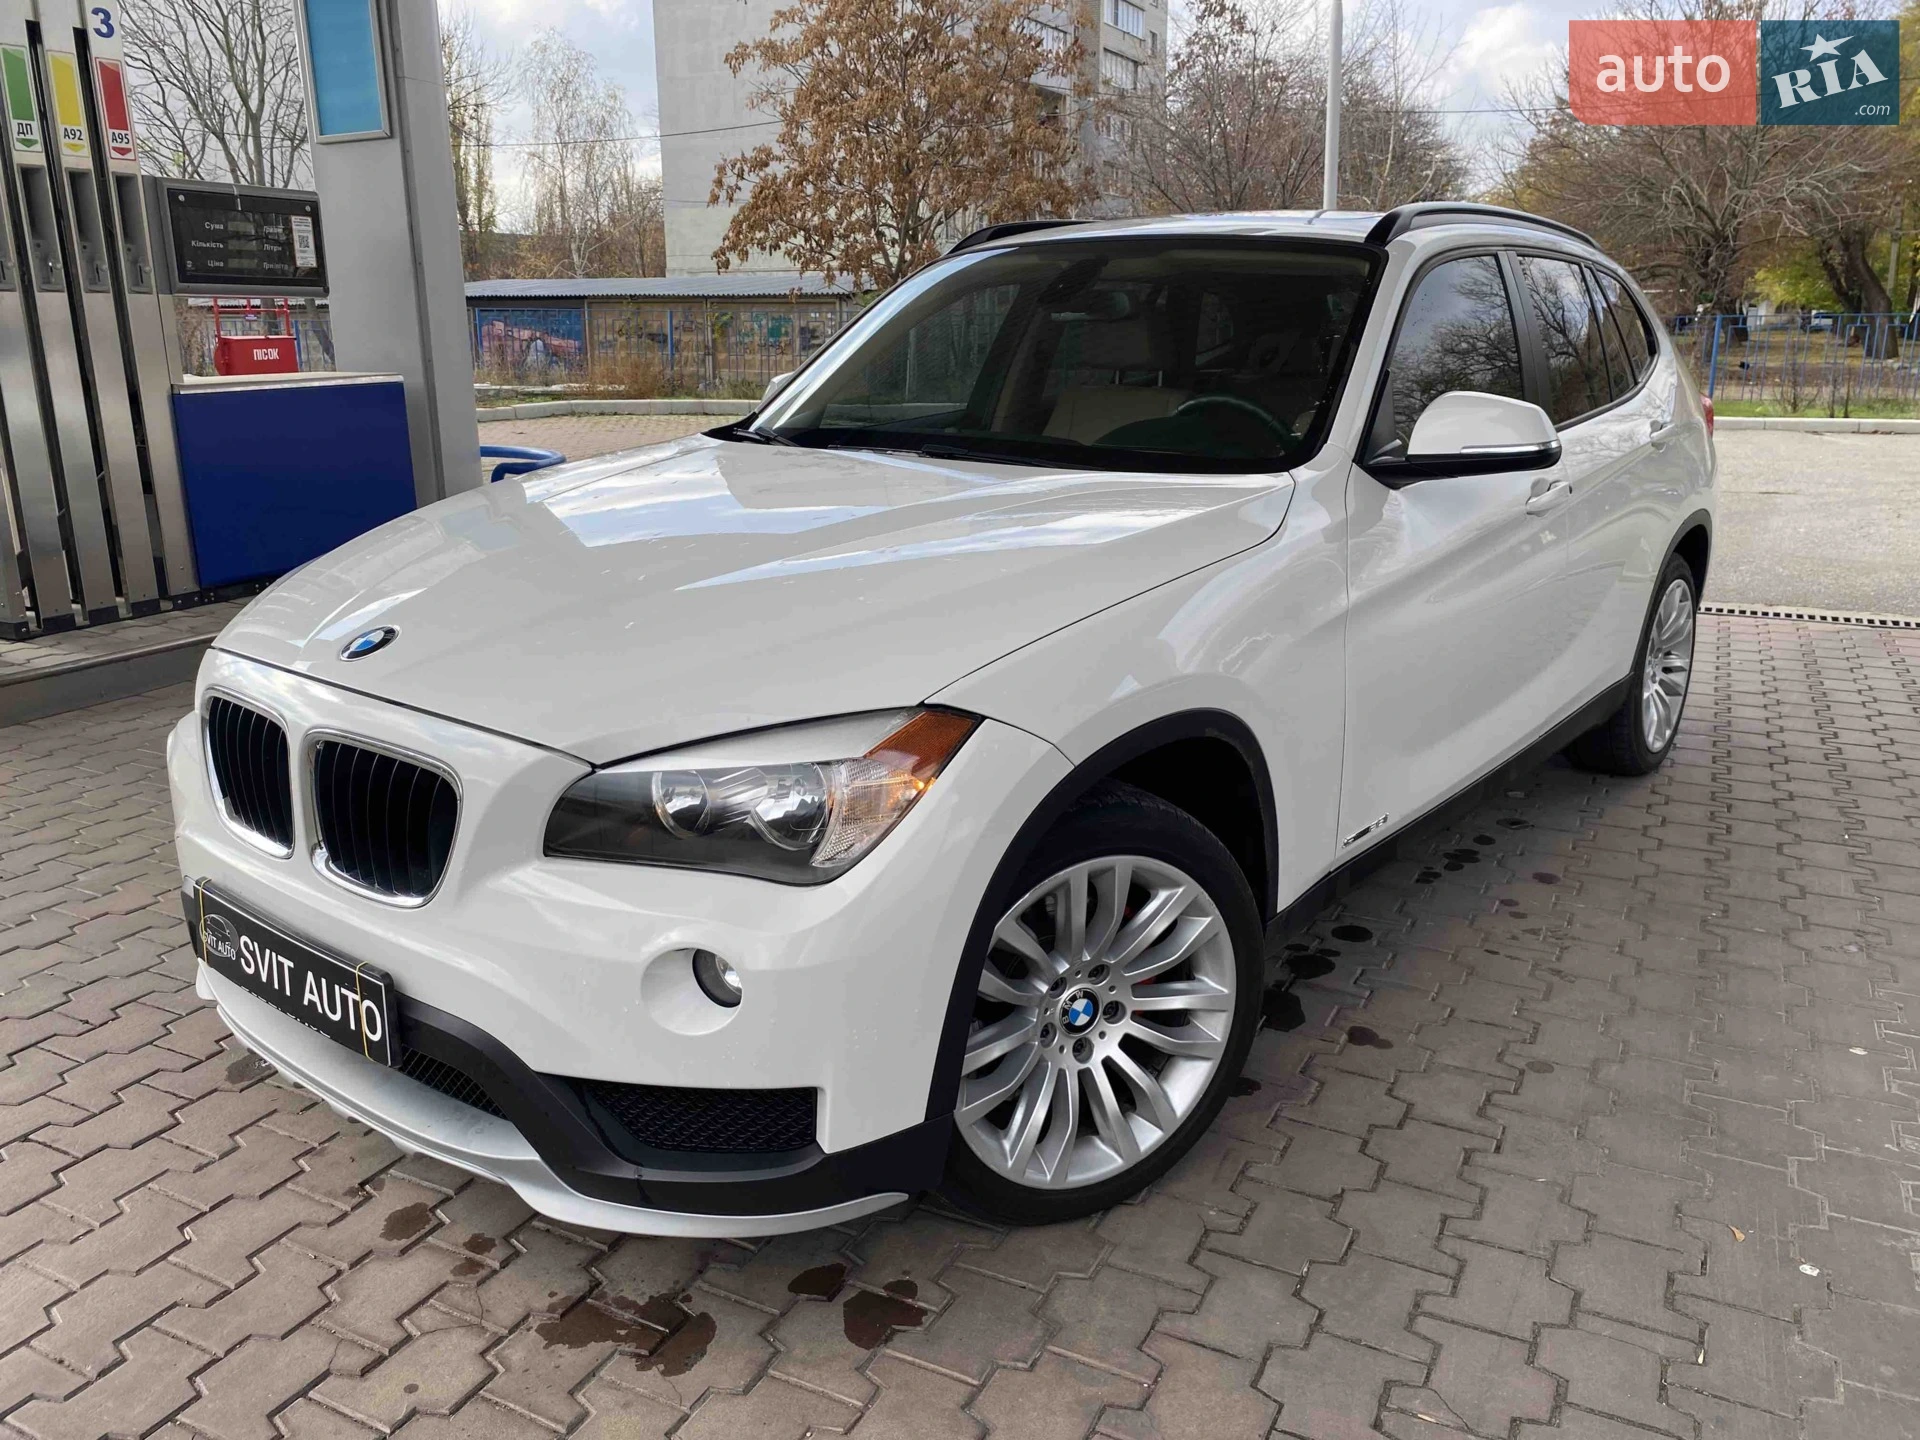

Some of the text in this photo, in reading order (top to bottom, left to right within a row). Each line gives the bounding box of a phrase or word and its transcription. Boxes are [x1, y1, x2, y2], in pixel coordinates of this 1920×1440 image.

[91, 6, 115, 39] 3
[17, 122, 33, 137] ДП
[63, 127, 84, 141] А92
[111, 131, 130, 145] А95
[207, 259, 224, 268] Ціна
[253, 348, 280, 361] ПІСОК
[218, 940, 236, 961] AUTO
[239, 934, 295, 997] SVIT
[302, 970, 382, 1043] AUTO
[1062, 990, 1084, 1025] BMW
